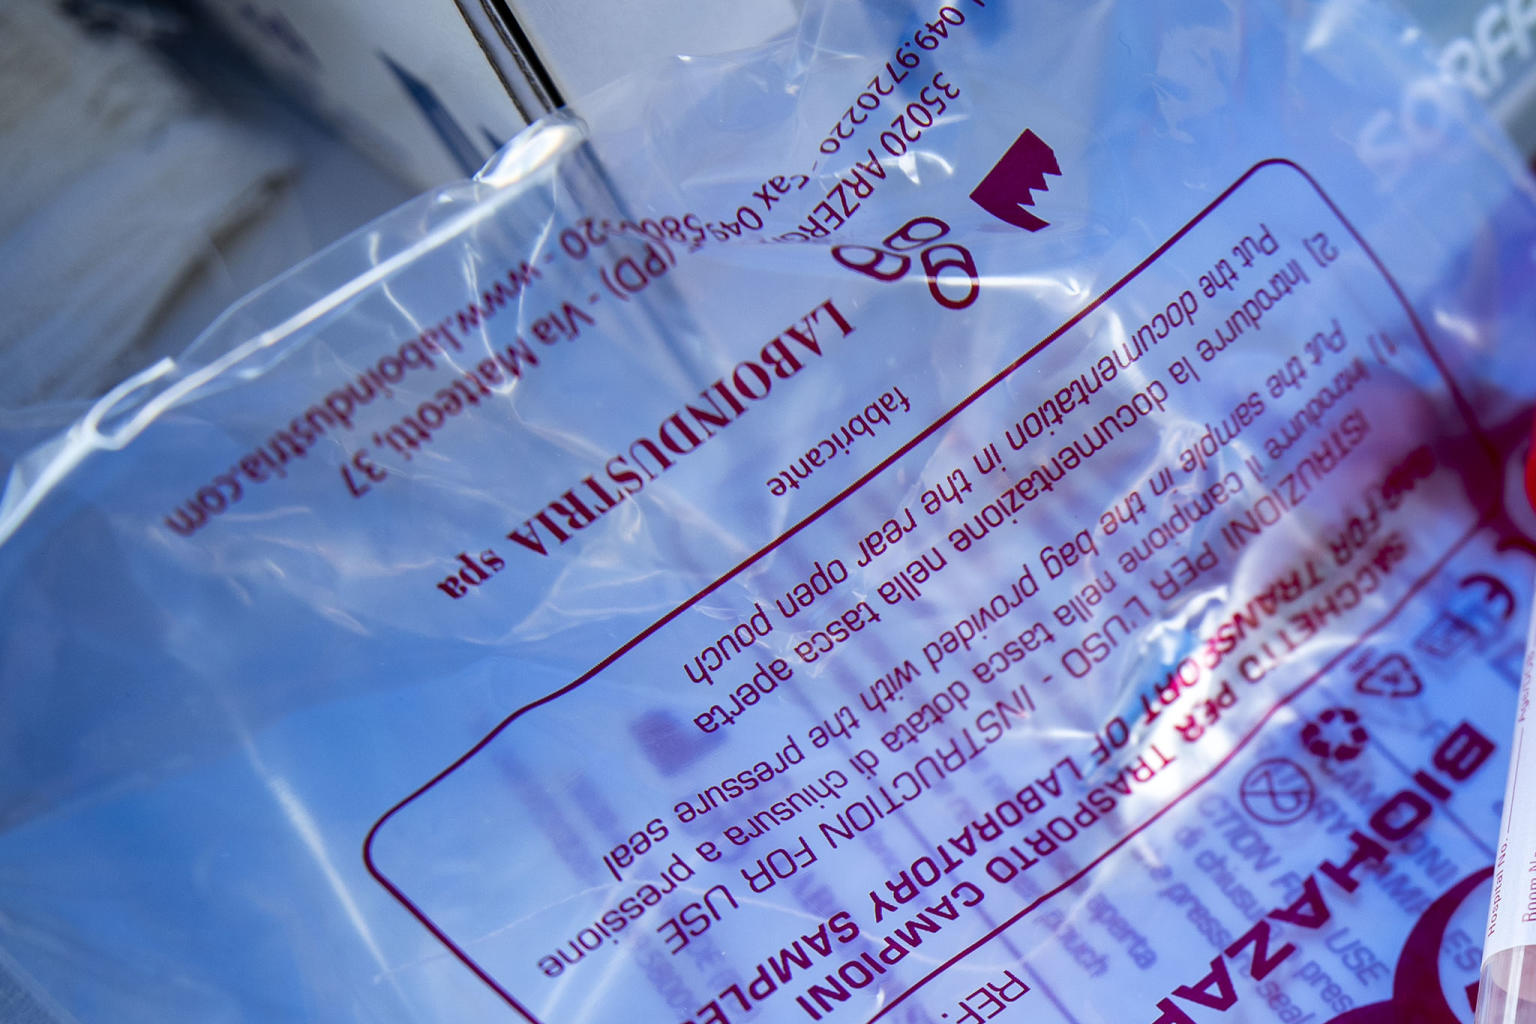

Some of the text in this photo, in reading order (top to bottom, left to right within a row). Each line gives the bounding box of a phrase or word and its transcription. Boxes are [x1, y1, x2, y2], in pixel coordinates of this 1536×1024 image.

[818, 4, 966, 155] 049.9720220
[876, 68, 961, 162] 35020
[529, 292, 596, 354] Via
[1192, 257, 1309, 366] Introdurre
[1166, 353, 1199, 392] la
[331, 445, 387, 501] 37
[429, 295, 856, 608] LABOINDUSTRIA spa
[681, 222, 1279, 692] Put the documentation in the rear open pouch
[764, 384, 913, 503] fabbricante
[944, 377, 1174, 559] documentazione
[1243, 452, 1268, 485] il
[1113, 468, 1246, 575] campione
[600, 317, 1351, 883] Put the sample in the bag provided with the pressure seal
[875, 544, 953, 615] nella
[1052, 568, 1120, 635] nella
[1232, 529, 1410, 685] SACCHETTO
[791, 595, 882, 671] tasca
[971, 618, 1057, 691] tasca
[652, 407, 1371, 957] ISTRUZIONI PER L'USO INSTRUCTION FOR USE
[691, 649, 794, 743] aperta
[877, 674, 977, 761] dotata
[1171, 678, 1240, 747] PER
[848, 746, 884, 783] di
[1080, 713, 1135, 766] OF
[694, 836, 723, 867] a
[721, 764, 853, 855] chiusura
[857, 755, 1082, 924] LABORATORY
[981, 737, 1174, 891] TRASPORTO
[534, 849, 695, 986] pressione
[792, 875, 984, 1024] CAMPIONI
[1321, 923, 1391, 991] USE
